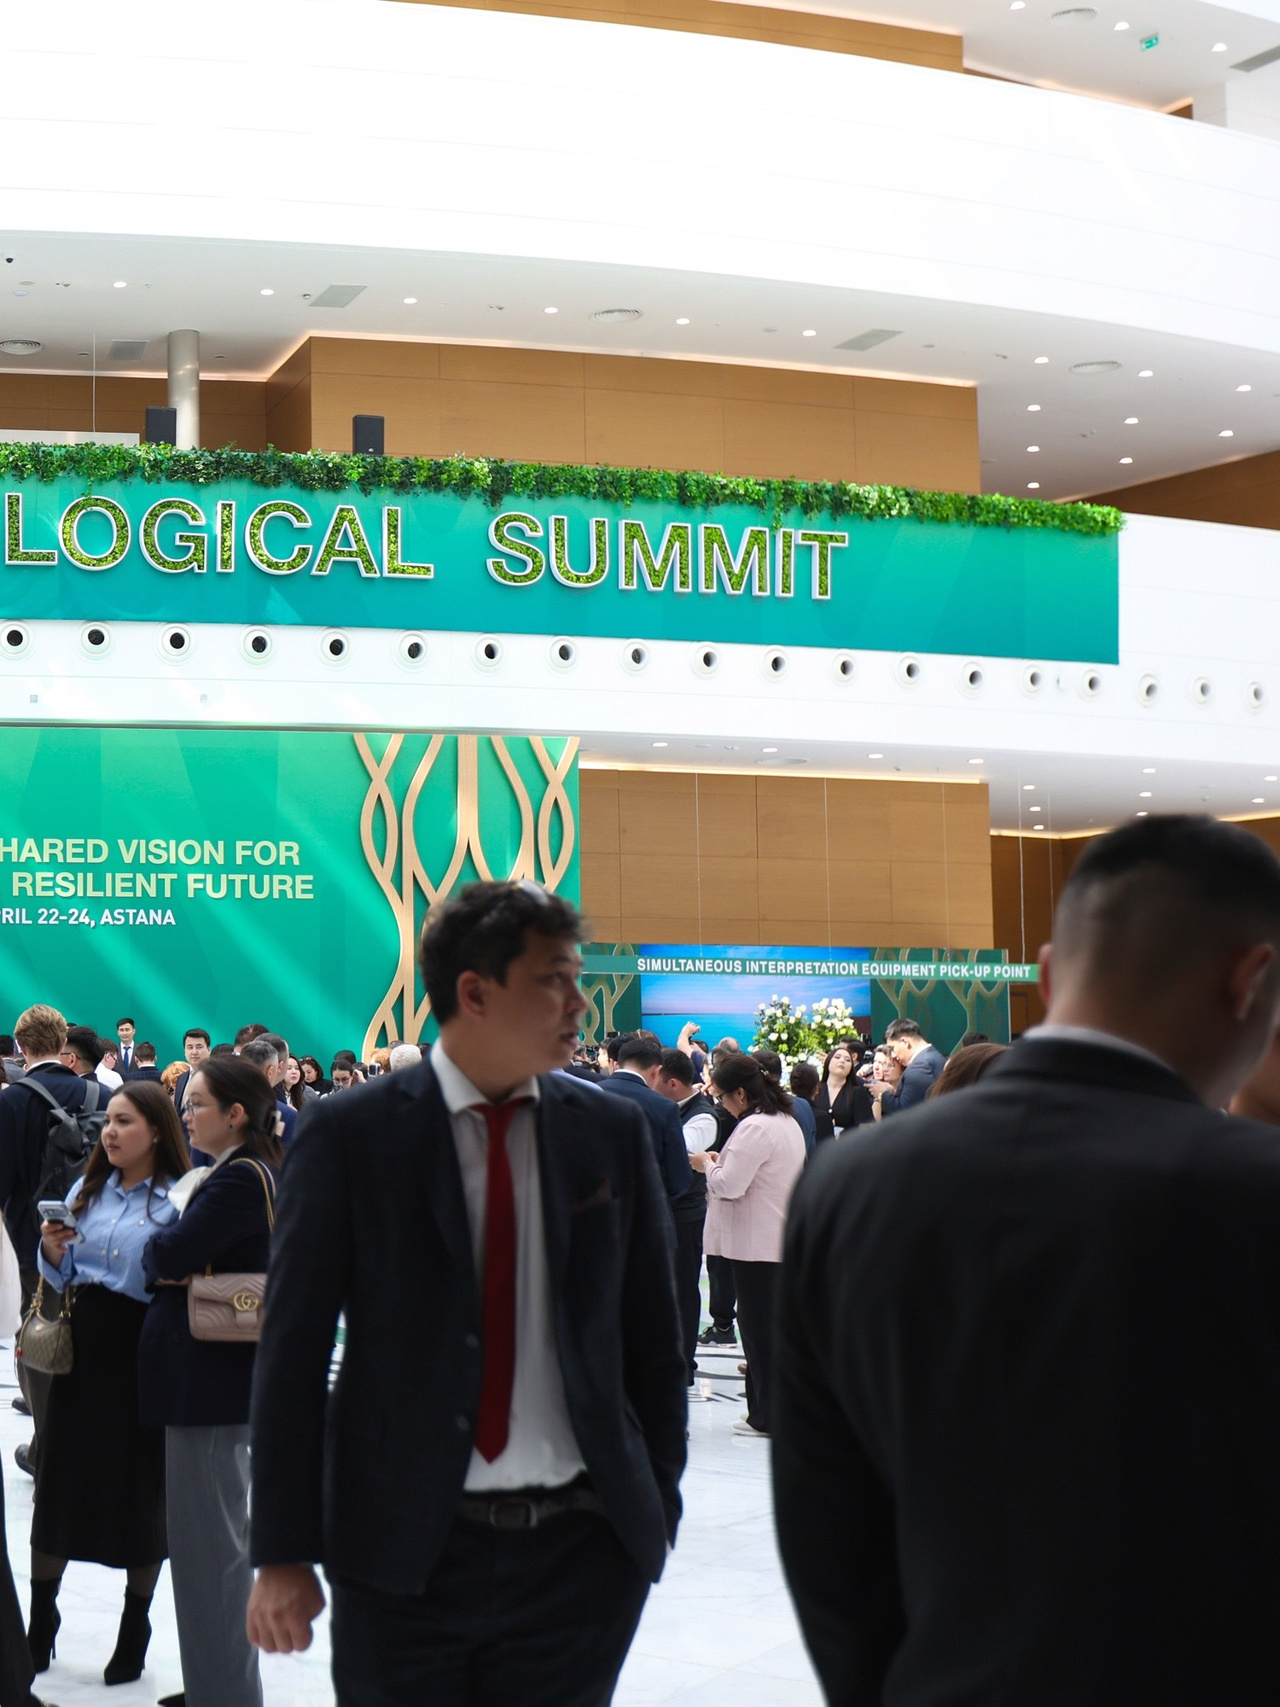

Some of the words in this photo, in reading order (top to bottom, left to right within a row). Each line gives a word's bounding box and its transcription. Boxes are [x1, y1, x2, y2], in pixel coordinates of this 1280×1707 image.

[486, 510, 850, 601] SUMMIT
[117, 839, 223, 865] VISION
[235, 840, 300, 866] FOR
[11, 872, 177, 898] RESILIENT
[187, 874, 314, 899] FUTURE
[37, 909, 96, 929] 22-24,
[100, 910, 176, 927] ASTANA
[636, 958, 742, 973] SIMULTANEOUS
[745, 960, 857, 975] INTERPRETATION
[862, 963, 936, 977] EQUIPMENT
[939, 964, 991, 977] PICK-UP
[993, 965, 1031, 978] POINT
